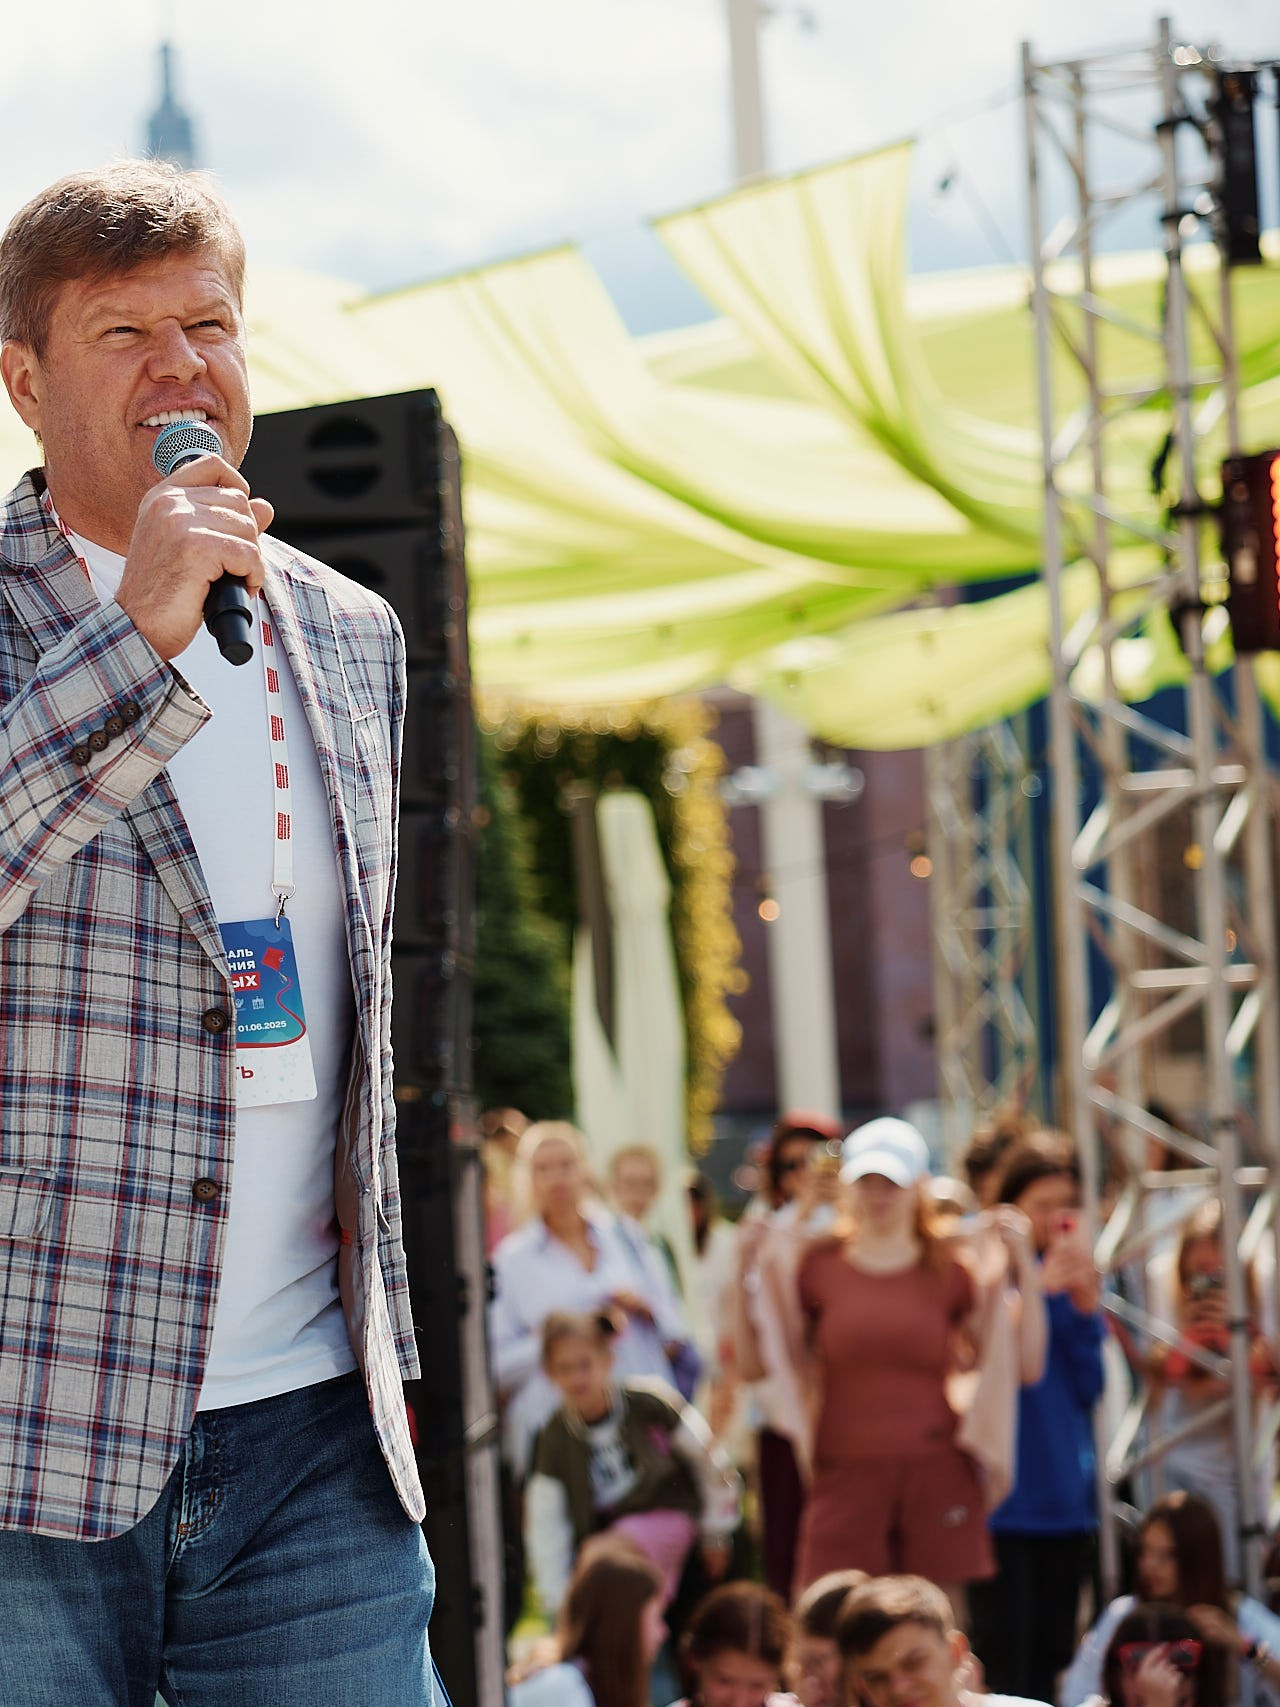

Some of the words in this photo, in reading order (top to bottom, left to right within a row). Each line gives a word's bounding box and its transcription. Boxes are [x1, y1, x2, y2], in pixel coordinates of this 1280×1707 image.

[227, 948, 254, 959] АЛЬ
[229, 960, 256, 972] НИЯ
[232, 974, 258, 989] ЫХ
[238, 1020, 287, 1032] 01.06.2025
[236, 1066, 254, 1079] Ь
